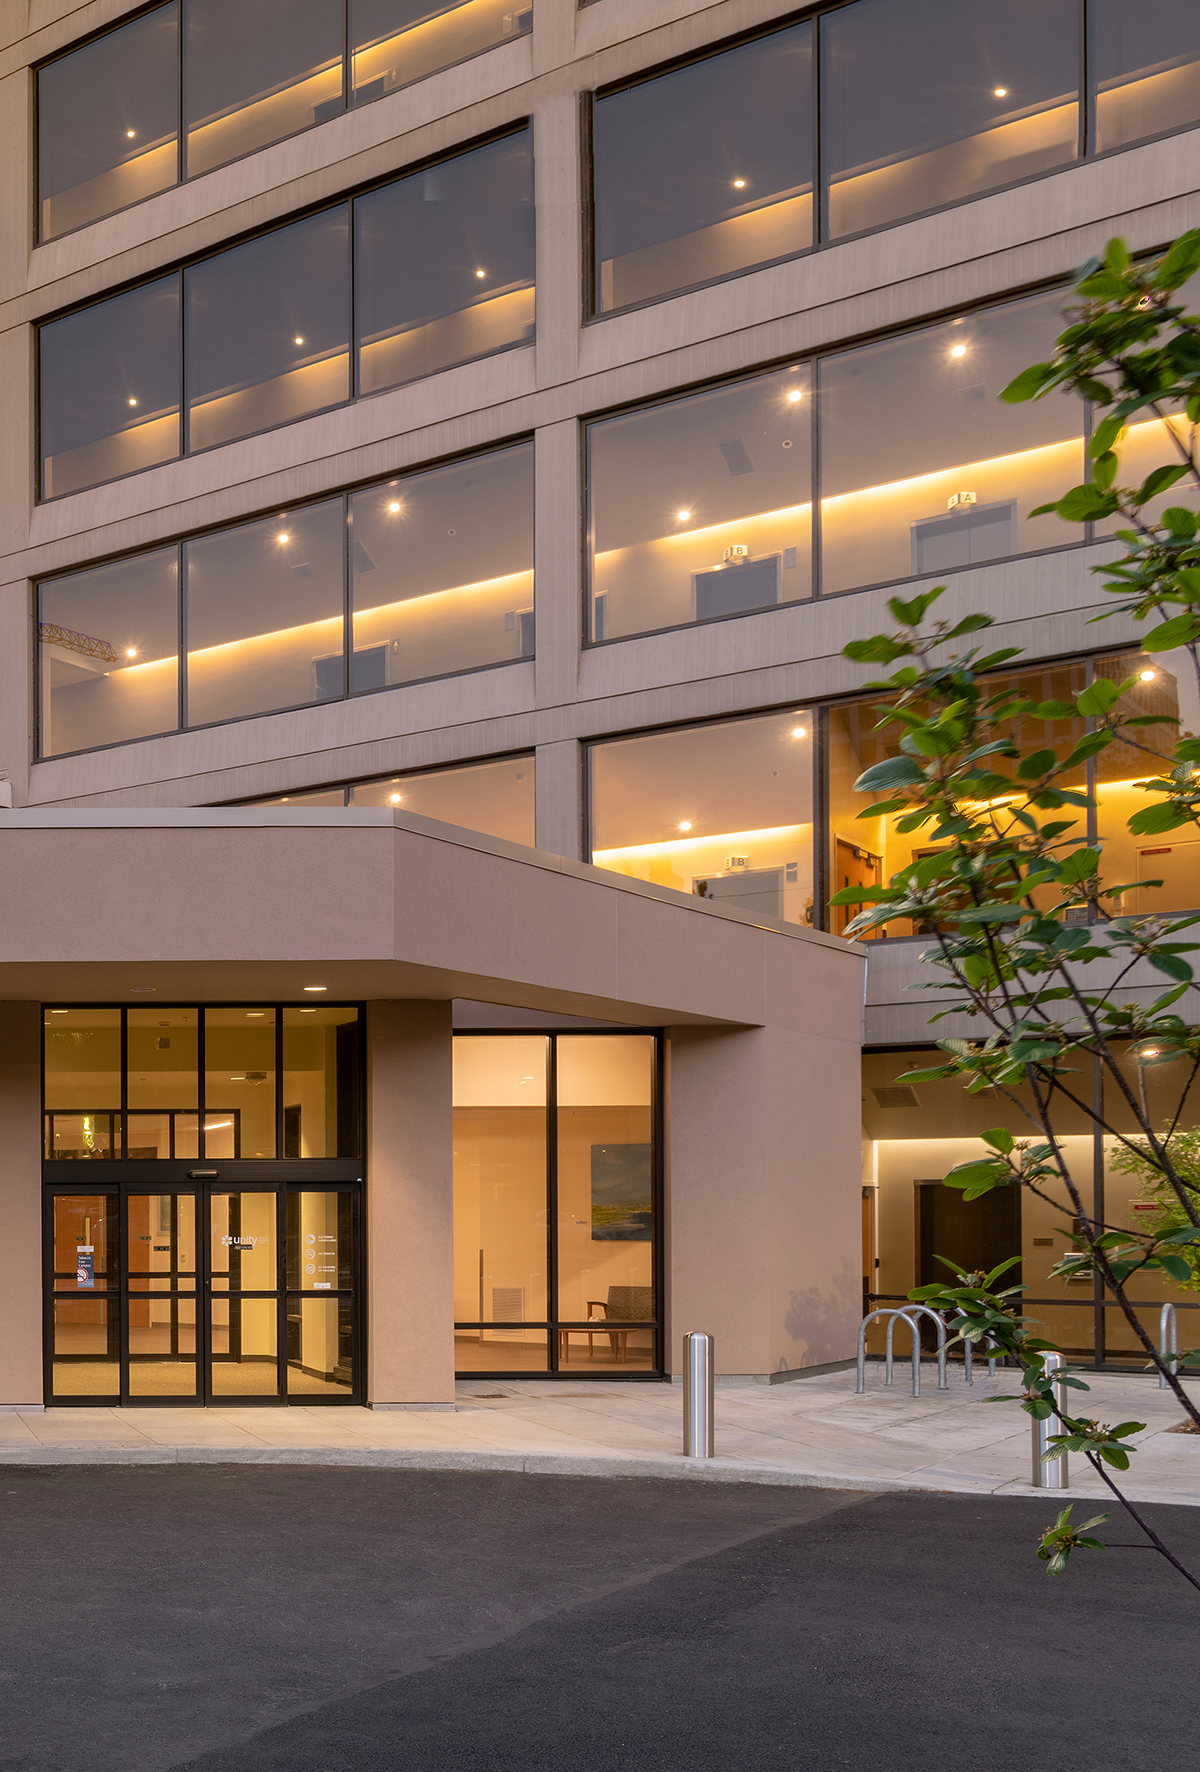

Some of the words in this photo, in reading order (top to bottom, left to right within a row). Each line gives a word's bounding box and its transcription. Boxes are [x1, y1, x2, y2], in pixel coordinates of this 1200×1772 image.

[964, 493, 972, 501] A
[736, 546, 743, 555] B
[737, 857, 745, 866] B
[233, 1235, 258, 1246] unity
